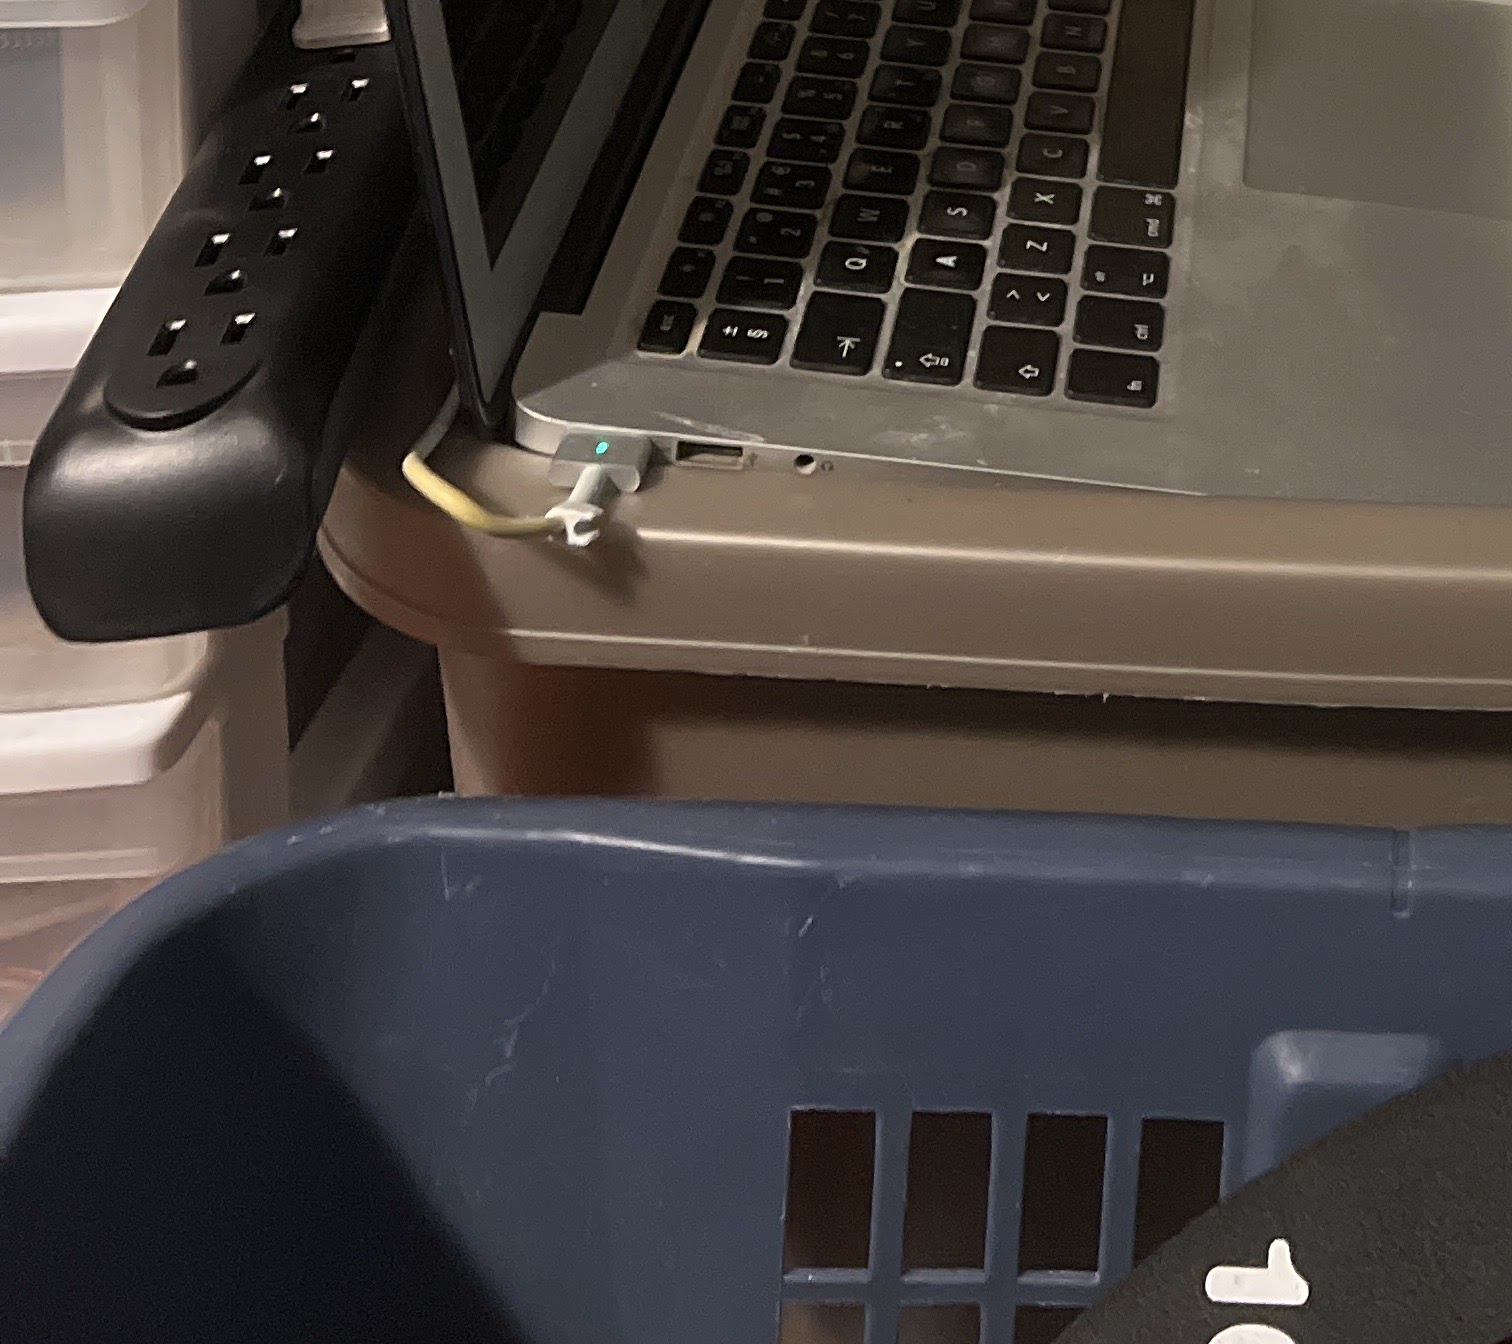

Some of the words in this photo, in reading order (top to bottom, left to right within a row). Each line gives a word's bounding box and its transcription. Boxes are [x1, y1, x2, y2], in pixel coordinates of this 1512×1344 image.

[1042, 148, 1064, 159] C
[1033, 192, 1056, 206] X
[856, 207, 880, 222] W
[946, 206, 969, 217] S
[1025, 239, 1049, 253] Z
[844, 257, 867, 271] Q
[935, 255, 959, 269] A
[1204, 1238, 1310, 1344] 1
